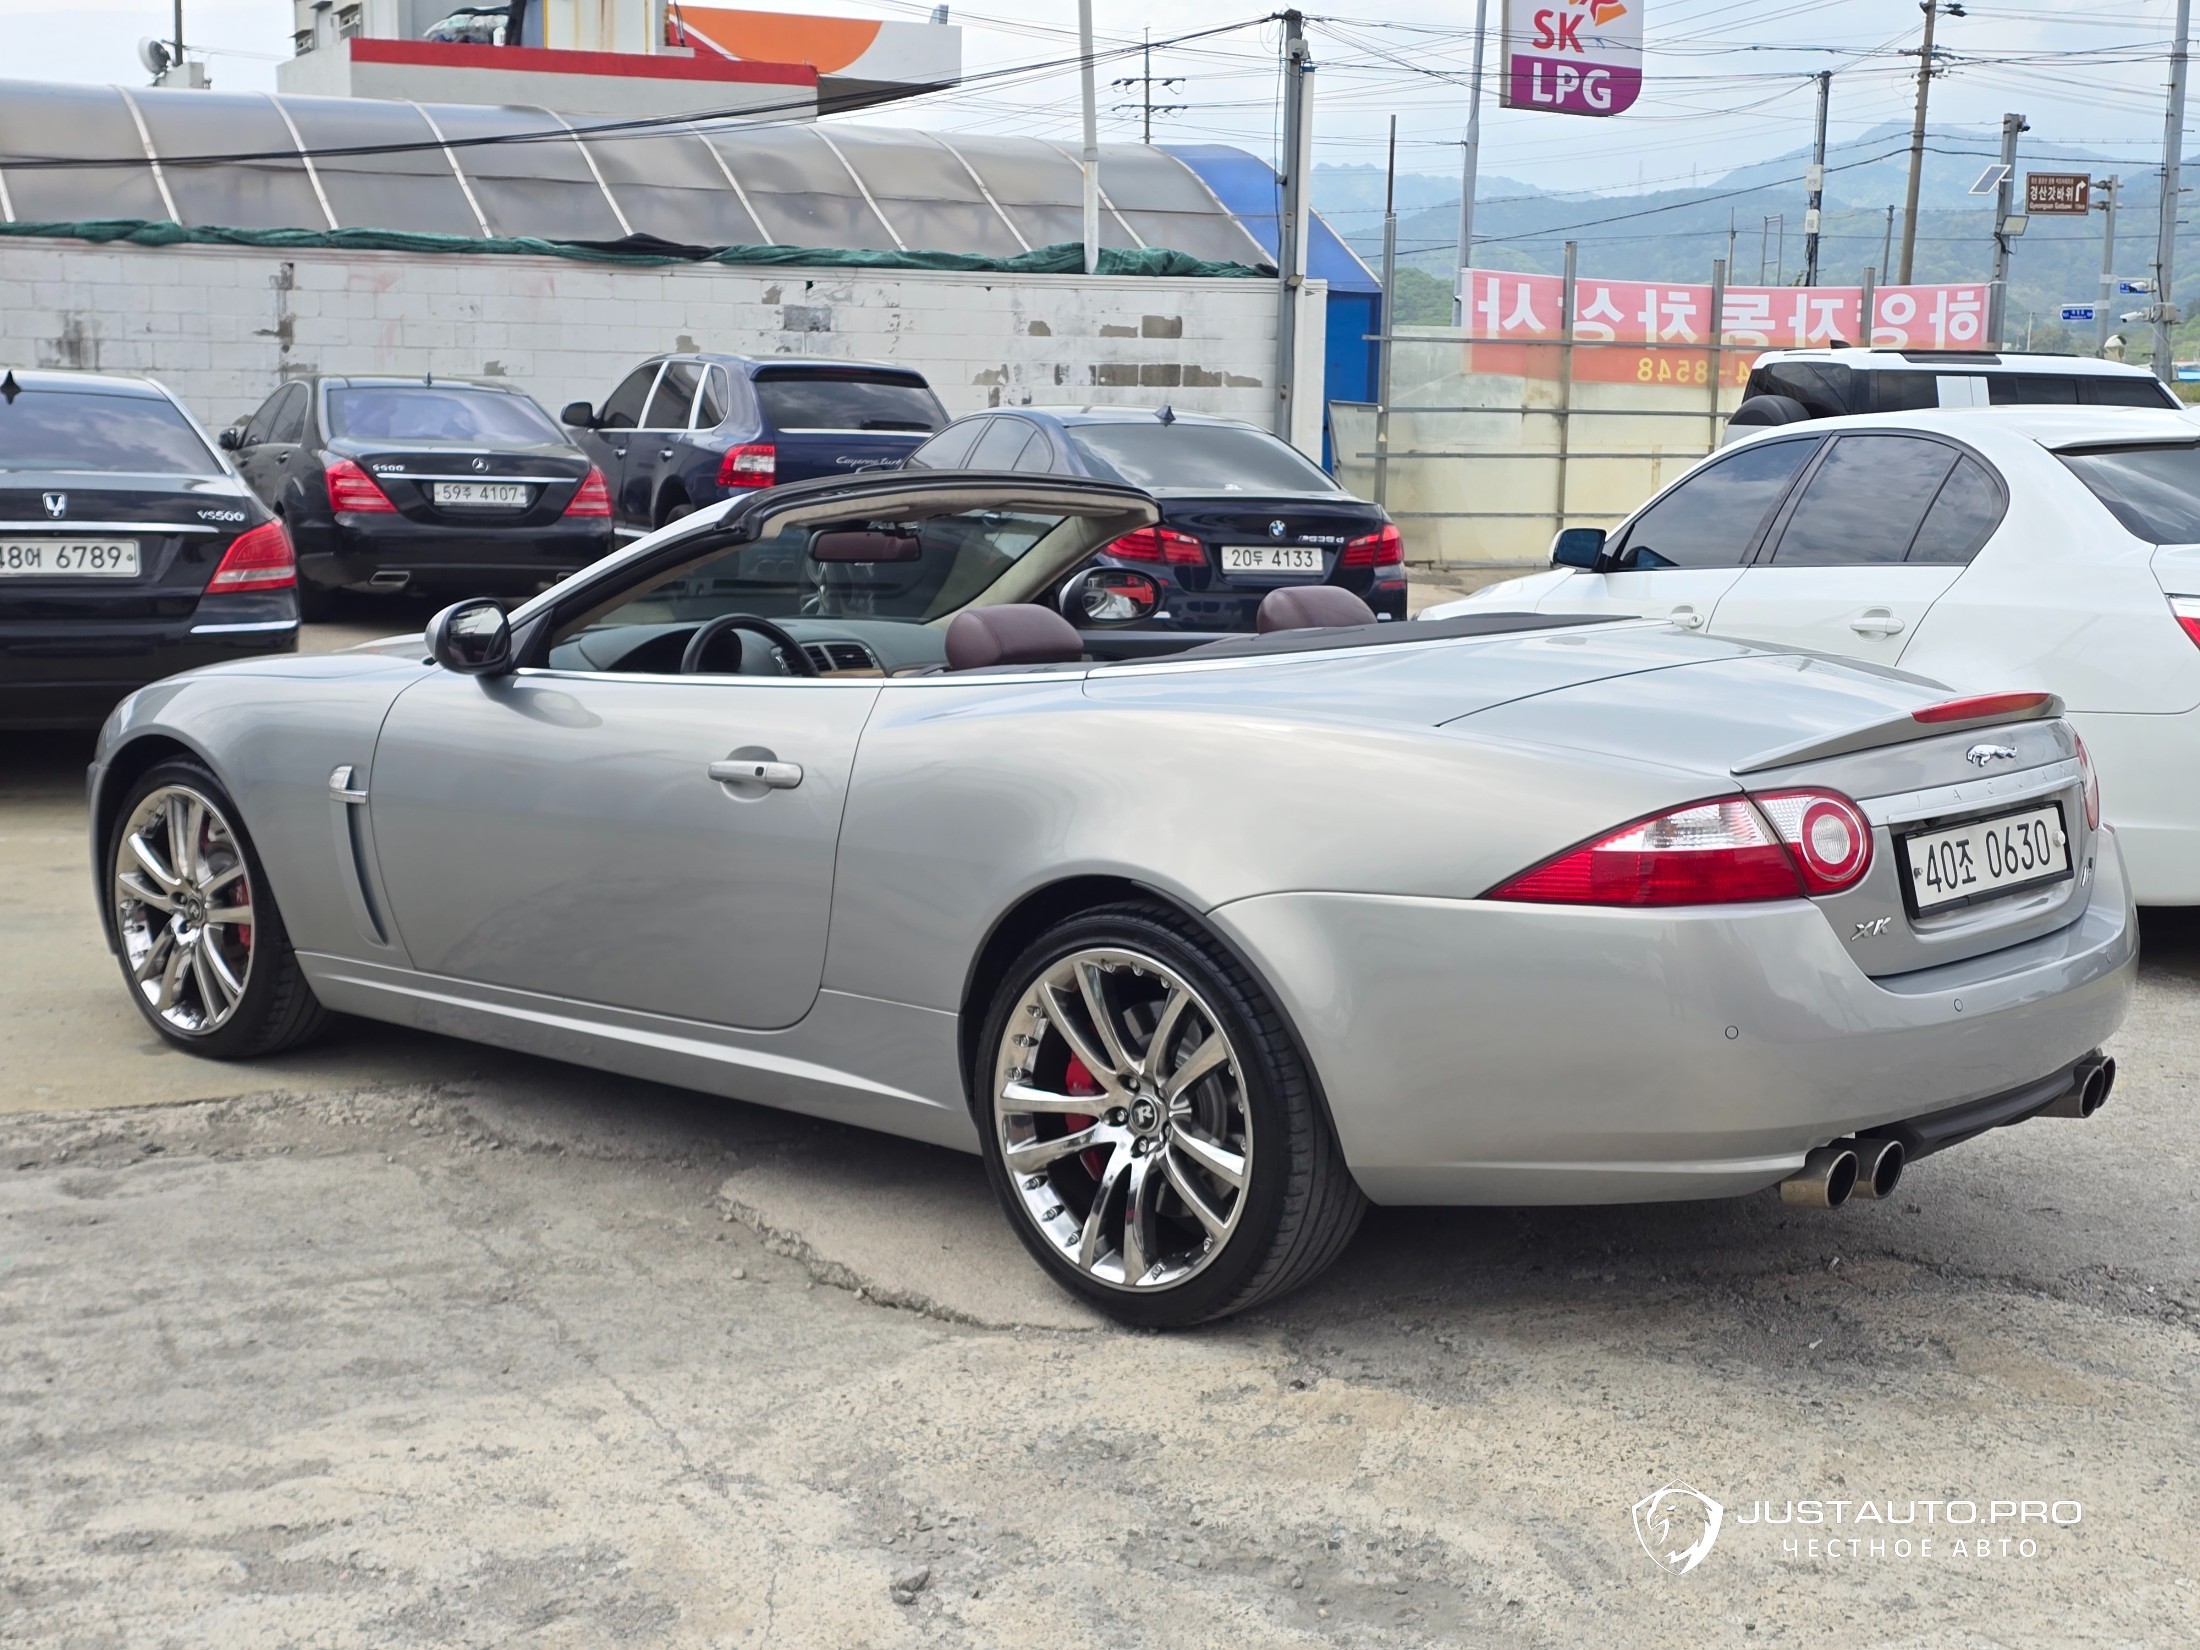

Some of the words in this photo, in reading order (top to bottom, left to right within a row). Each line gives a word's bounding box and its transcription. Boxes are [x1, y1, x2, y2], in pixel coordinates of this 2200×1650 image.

[1532, 9, 1585, 53] SK
[1533, 62, 1611, 109] LPG
[2030, 185, 2074, 201] 경산갓바위
[479, 486, 518, 501] 4107
[198, 510, 245, 521] VS500
[56, 546, 121, 568] 6789
[1232, 549, 1263, 566] 20두
[1272, 550, 1313, 567] 4133
[1926, 838, 1977, 893] 40조
[1985, 819, 2051, 878] 0630
[1851, 916, 1892, 941] XK
